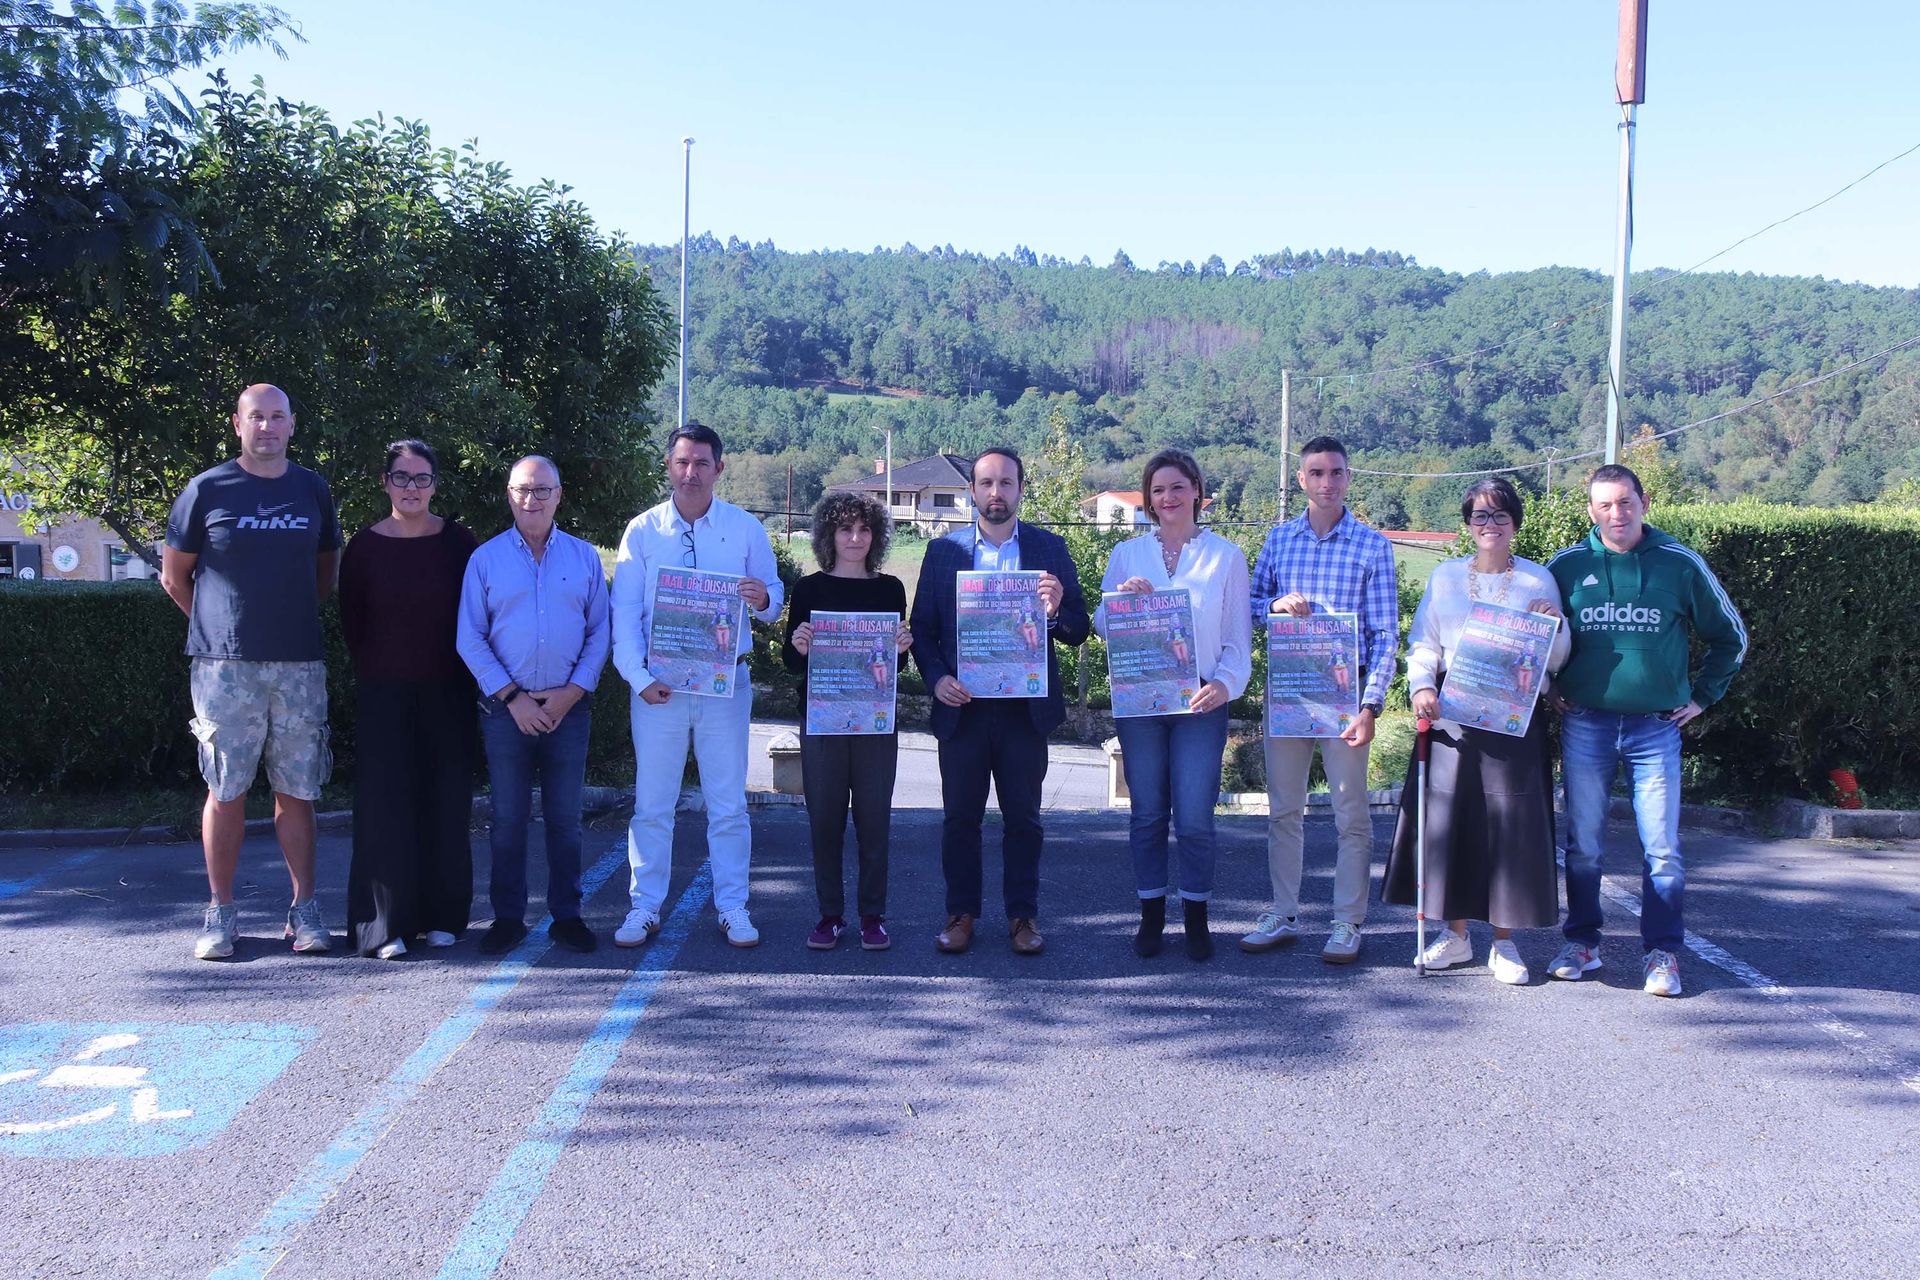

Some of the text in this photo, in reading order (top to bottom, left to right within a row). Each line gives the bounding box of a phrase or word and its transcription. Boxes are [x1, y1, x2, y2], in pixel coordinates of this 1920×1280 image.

[661, 574, 684, 589] TRAIL
[700, 579, 739, 596] LOUSAME
[961, 578, 985, 592] TRAIL
[1001, 578, 1040, 592] LOUSAM
[1108, 600, 1133, 614] TRAIL
[1148, 594, 1188, 612] LOUSAME
[1580, 602, 1661, 624] adidas
[815, 619, 838, 632] TRAIL
[853, 620, 894, 633] LOUSAME
[1272, 621, 1296, 634] TRAIL
[1312, 620, 1352, 634] LOUSAME
[1507, 616, 1553, 638] LOUSAME
[1580, 624, 1660, 633] SPORTSWEAR
